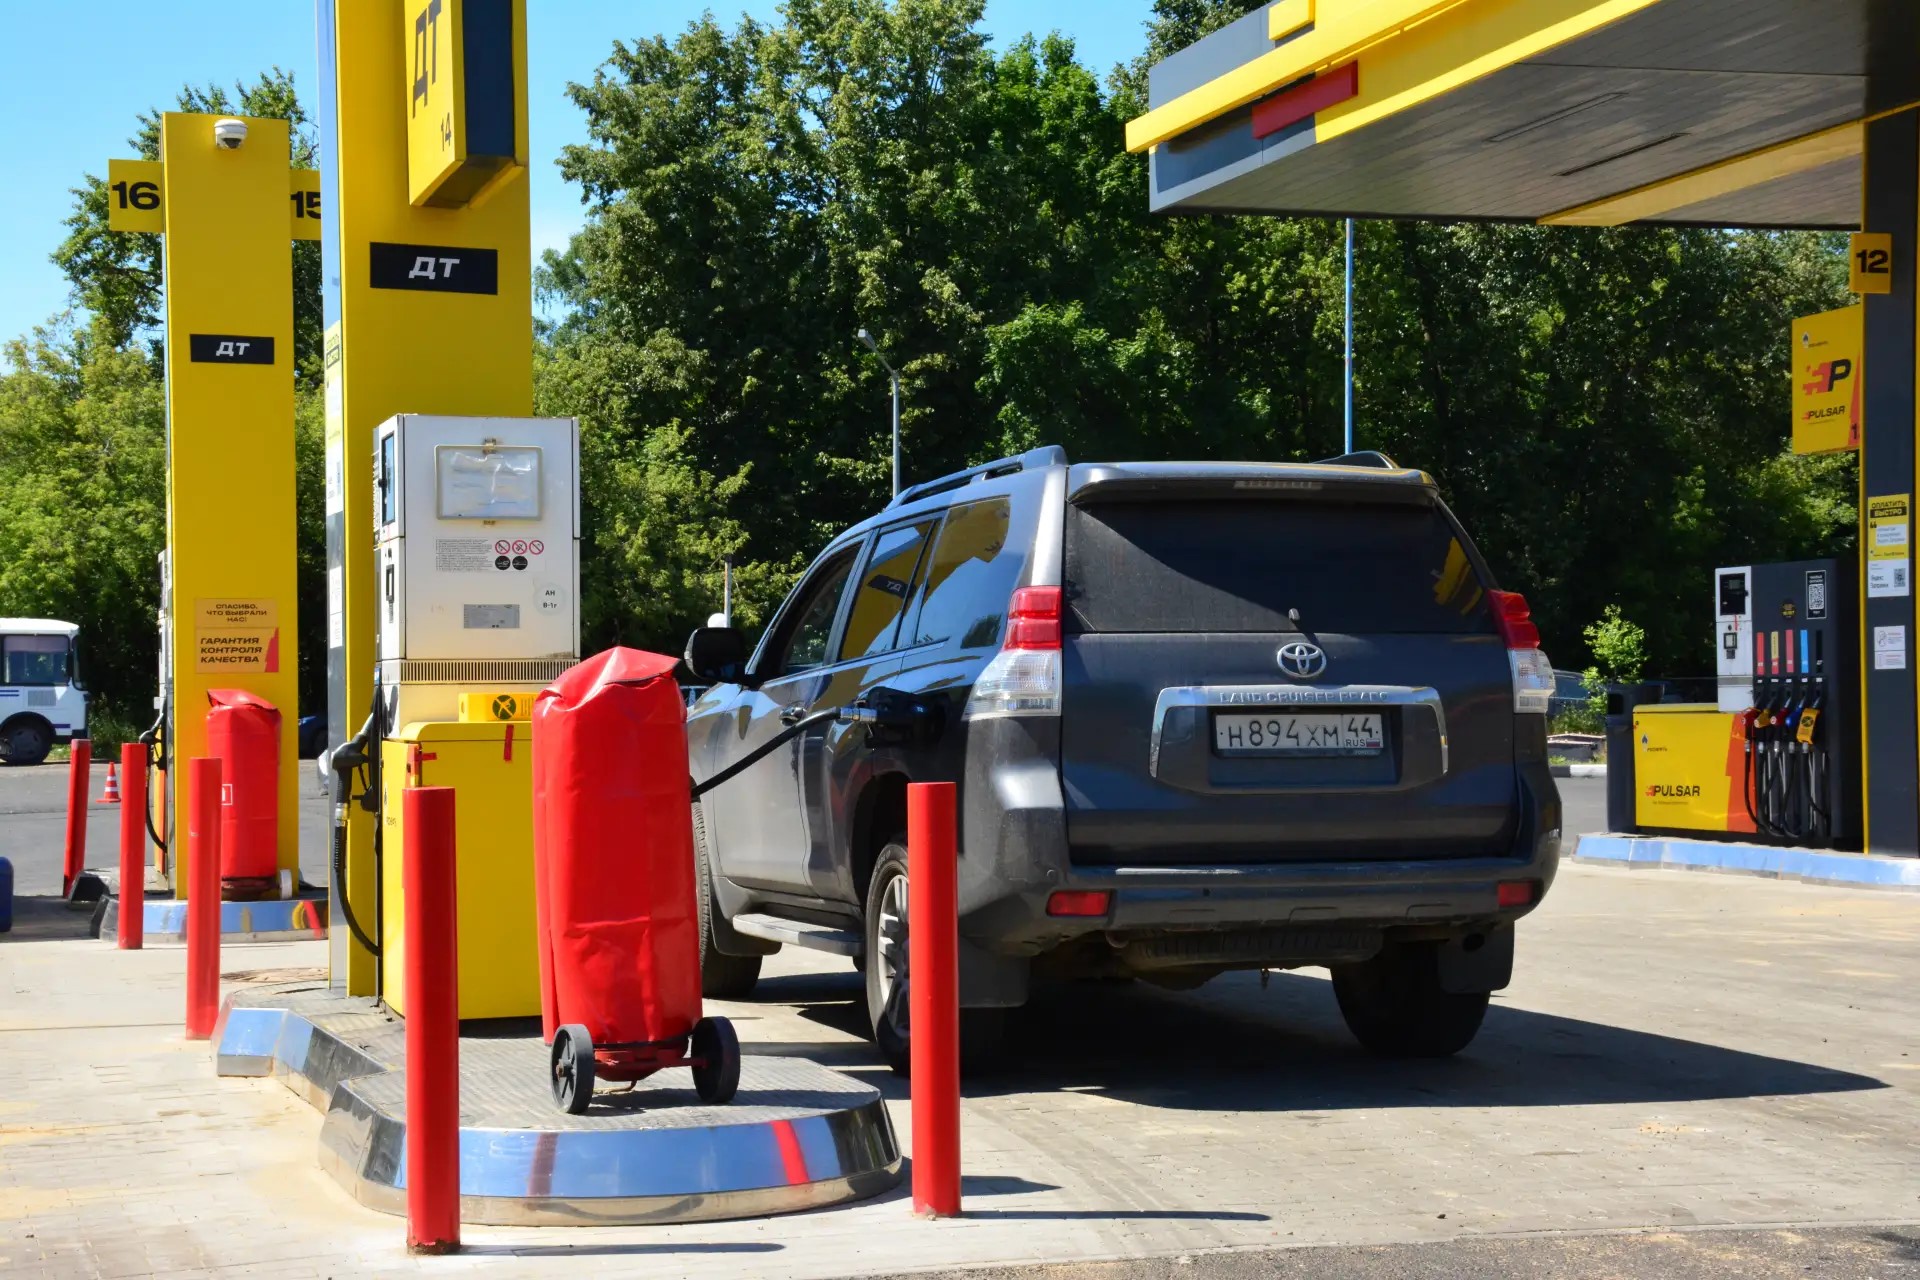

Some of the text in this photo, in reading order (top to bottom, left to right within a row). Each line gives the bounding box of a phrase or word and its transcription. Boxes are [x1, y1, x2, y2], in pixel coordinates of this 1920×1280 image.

[412, 0, 442, 119] ДТ
[440, 111, 452, 151] 14
[111, 181, 161, 210] 16
[290, 191, 321, 219] 15
[408, 256, 461, 280] ДТ
[1855, 248, 1889, 273] 12
[215, 341, 251, 357] ДТ
[1807, 405, 1846, 420] PULSAR
[200, 637, 260, 645] ГАРАНТИЯ
[200, 646, 263, 654] КОНТРОЛЯ
[200, 656, 260, 664] КАЧЕСТВА
[1346, 717, 1374, 738] 44
[1345, 738, 1366, 747] RUS
[1653, 785, 1701, 797] PULSAR
